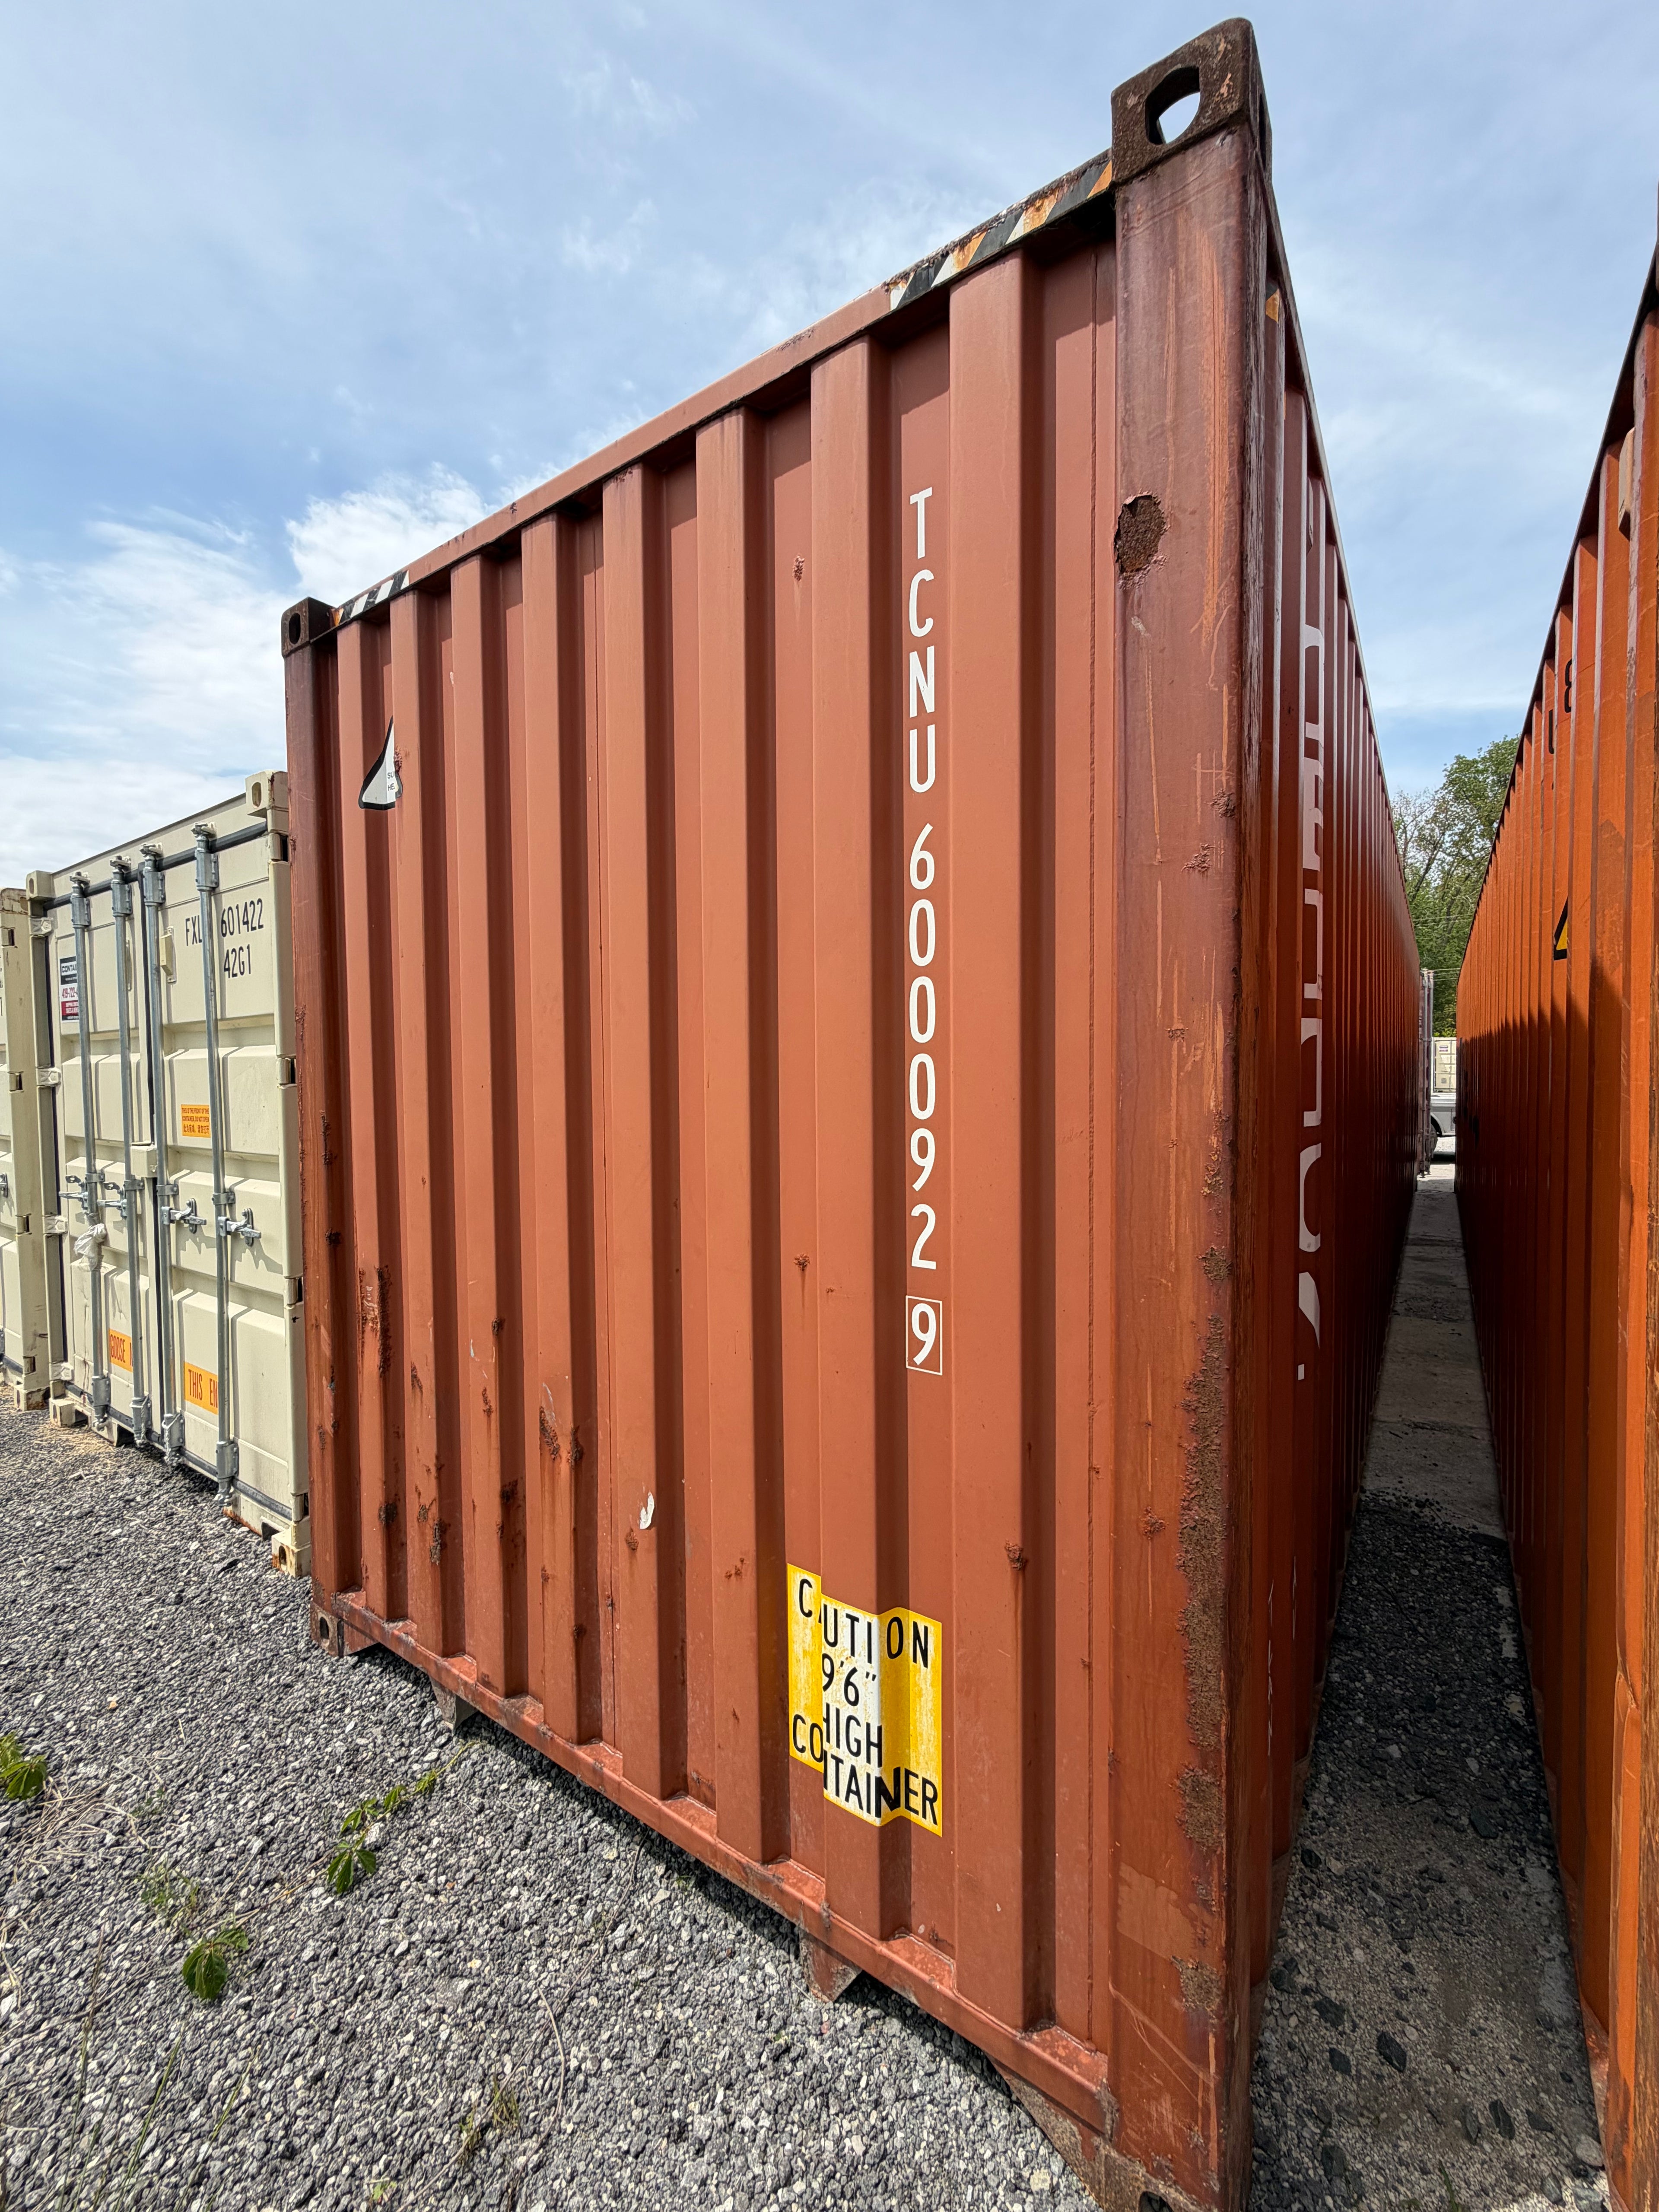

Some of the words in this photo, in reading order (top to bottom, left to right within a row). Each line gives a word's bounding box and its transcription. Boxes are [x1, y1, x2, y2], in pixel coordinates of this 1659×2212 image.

[909, 486, 936, 793] TCNU
[185, 915, 202, 946] FXL
[221, 898, 264, 938] 601422
[224, 944, 251, 979] 42G1
[909, 823, 936, 1270] 600092
[110, 1334, 125, 1363] GOOSE
[912, 1303, 936, 1365] 9
[188, 1369, 203, 1401] THIS
[209, 1378, 218, 1408] EN
[798, 1578, 928, 1669] CUTION
